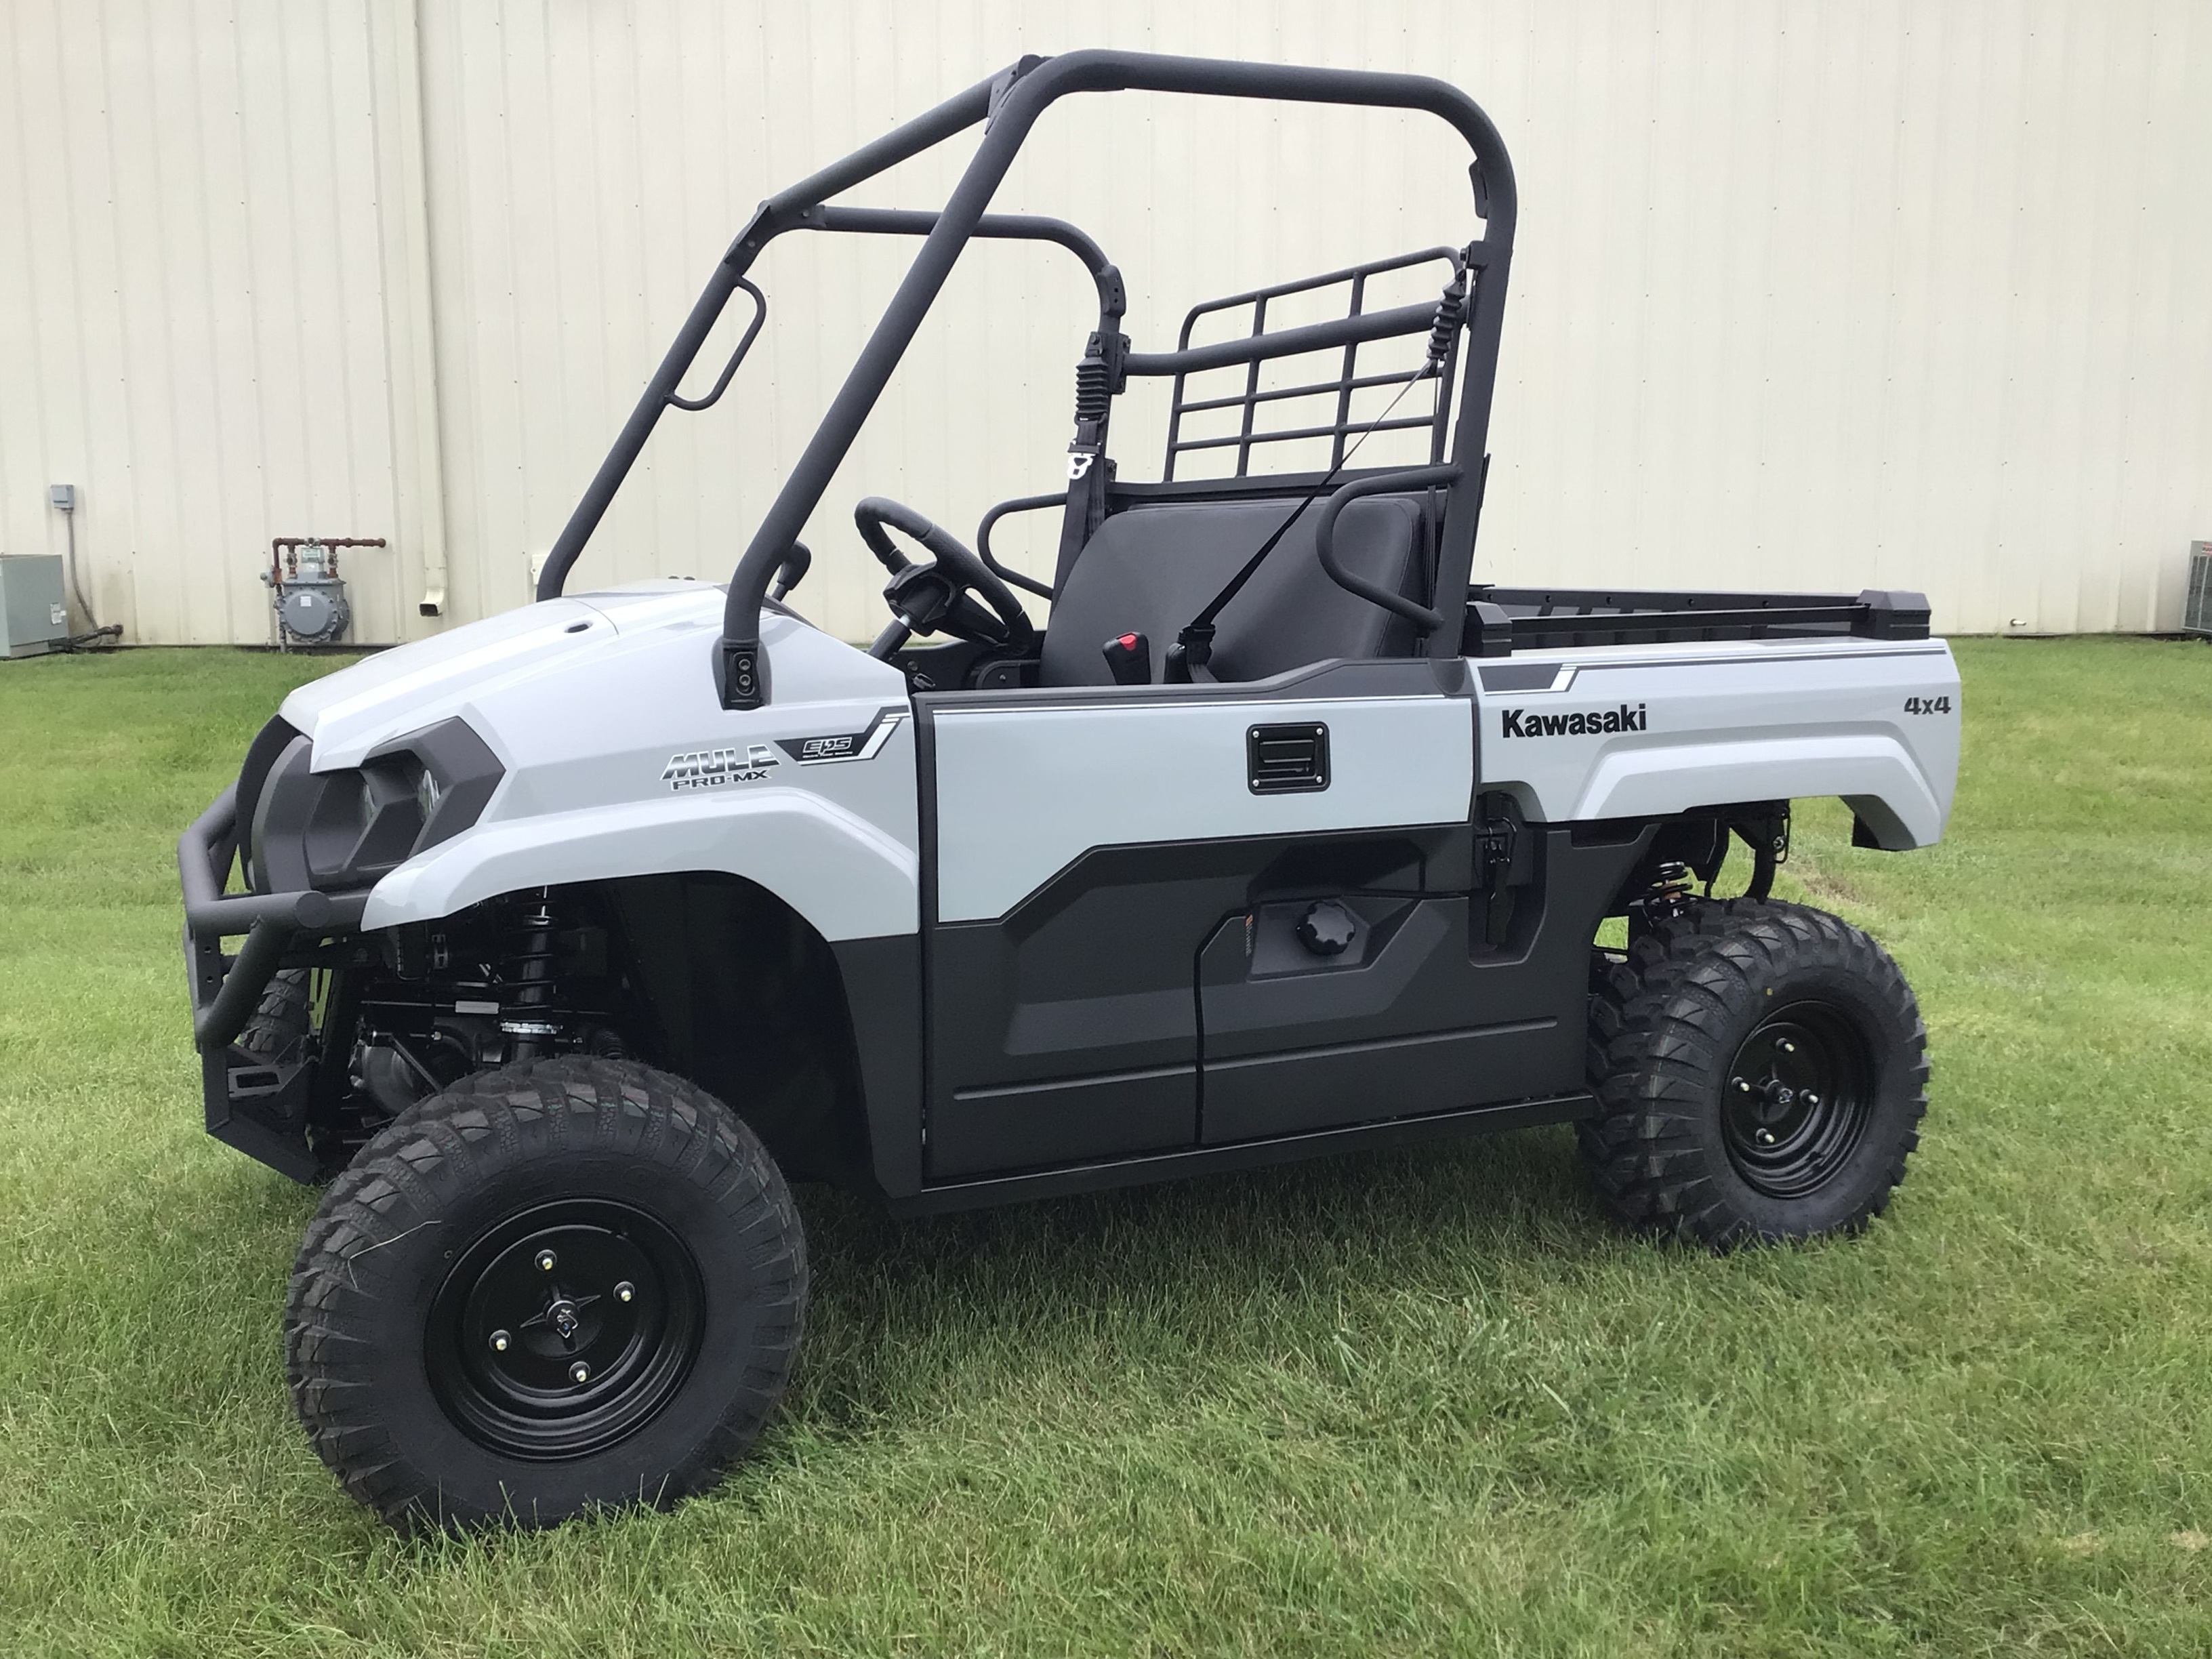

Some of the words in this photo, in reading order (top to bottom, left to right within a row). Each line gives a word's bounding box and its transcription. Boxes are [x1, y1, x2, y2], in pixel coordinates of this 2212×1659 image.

[1904, 696, 1951, 715] 4x4
[1502, 703, 1647, 738] Kawasaki
[660, 744, 781, 780] MULE
[672, 769, 771, 791] PRO-MX
